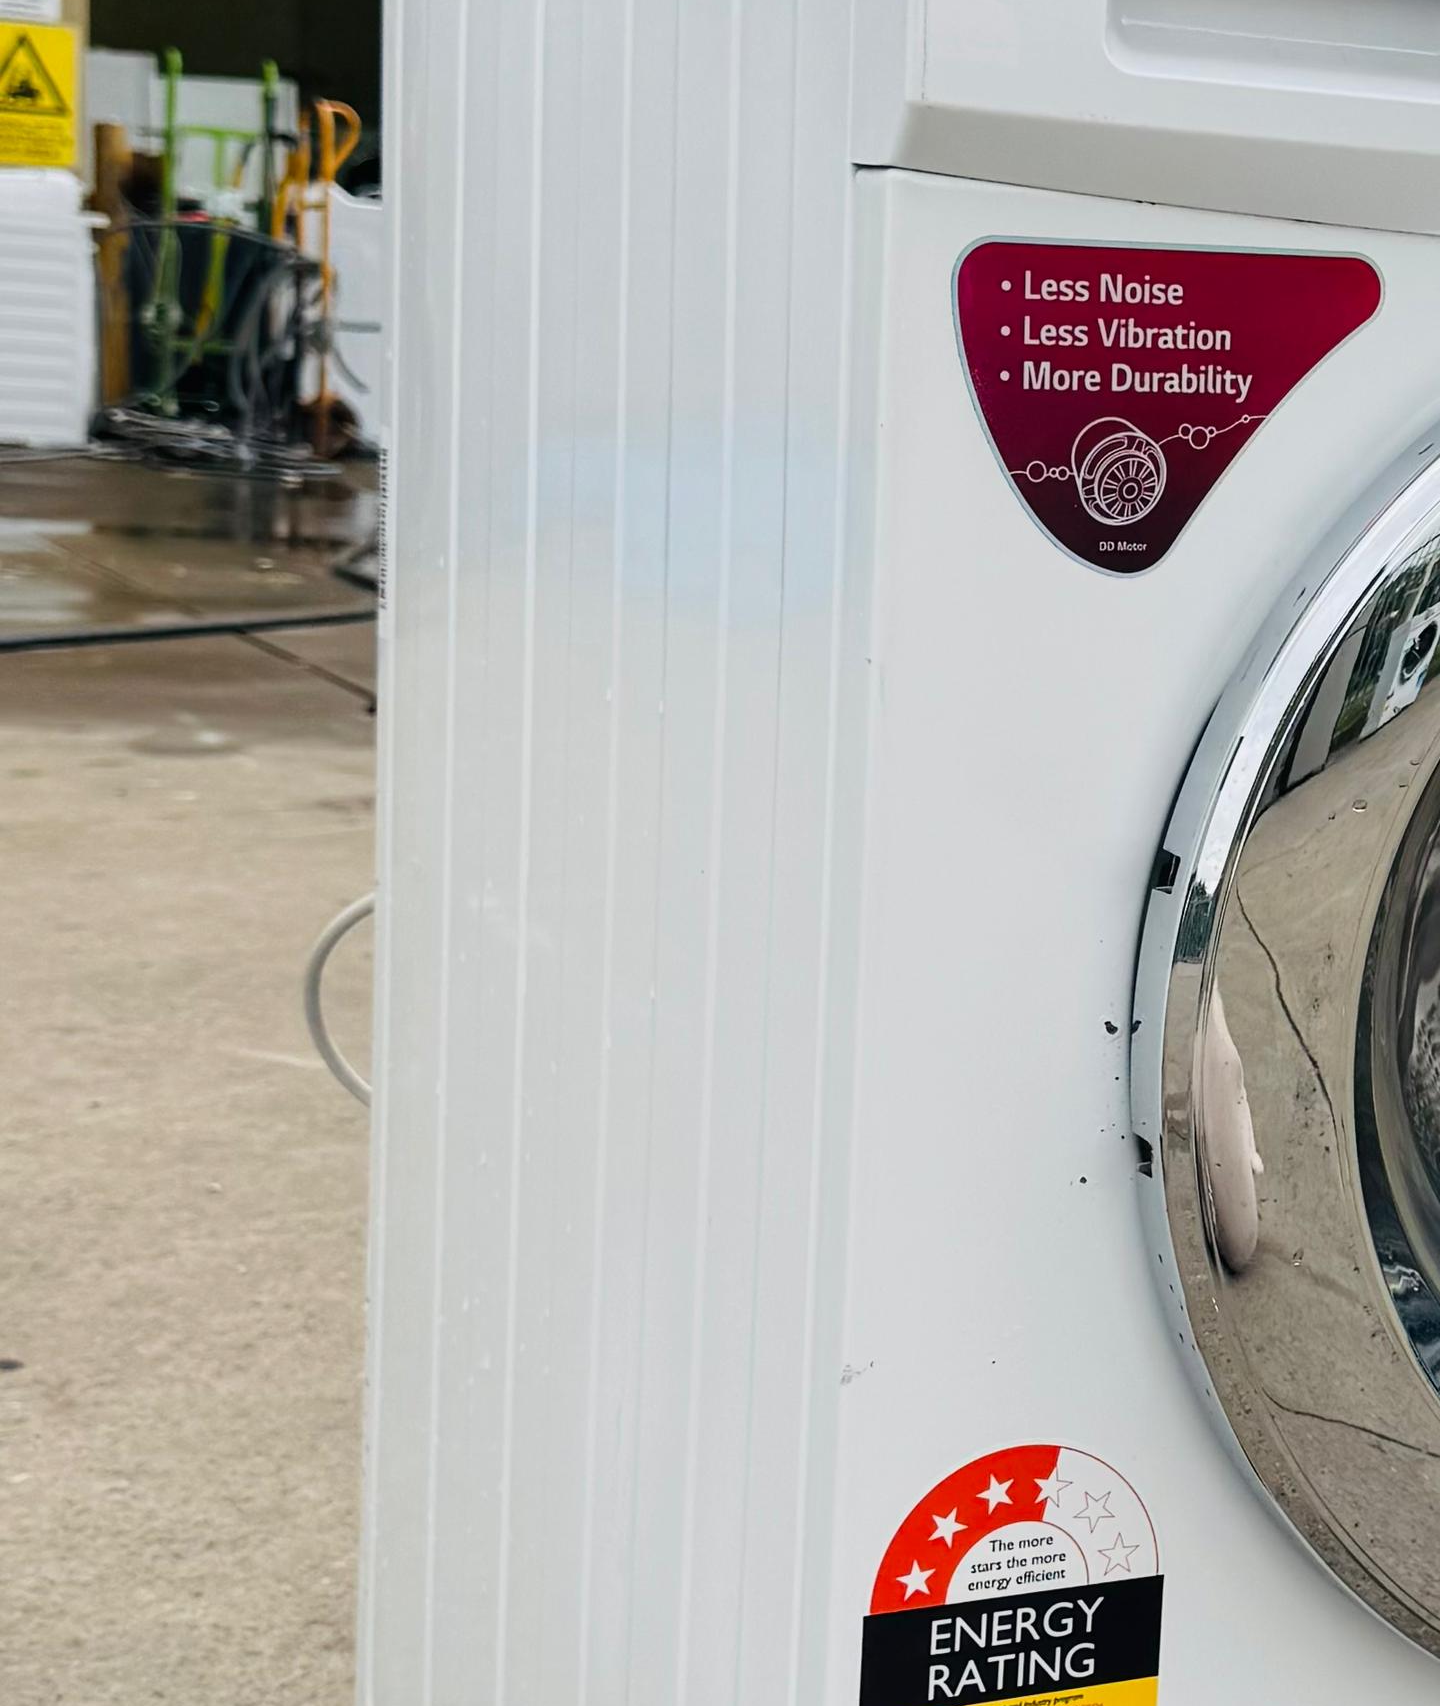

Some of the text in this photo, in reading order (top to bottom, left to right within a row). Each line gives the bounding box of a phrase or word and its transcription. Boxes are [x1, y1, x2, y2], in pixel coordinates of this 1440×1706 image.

[1025, 271, 1184, 305] Less Noise
[1024, 316, 1232, 351] Less Vibration
[1023, 361, 1252, 403] More Durability
[1099, 541, 1147, 552] DD Motor
[989, 1535, 1053, 1552] The more
[971, 1552, 1066, 1573] stars the more
[968, 1569, 1065, 1591] energy efficient
[930, 1597, 1104, 1656] ENERGY
[927, 1643, 1096, 1700] RATING
